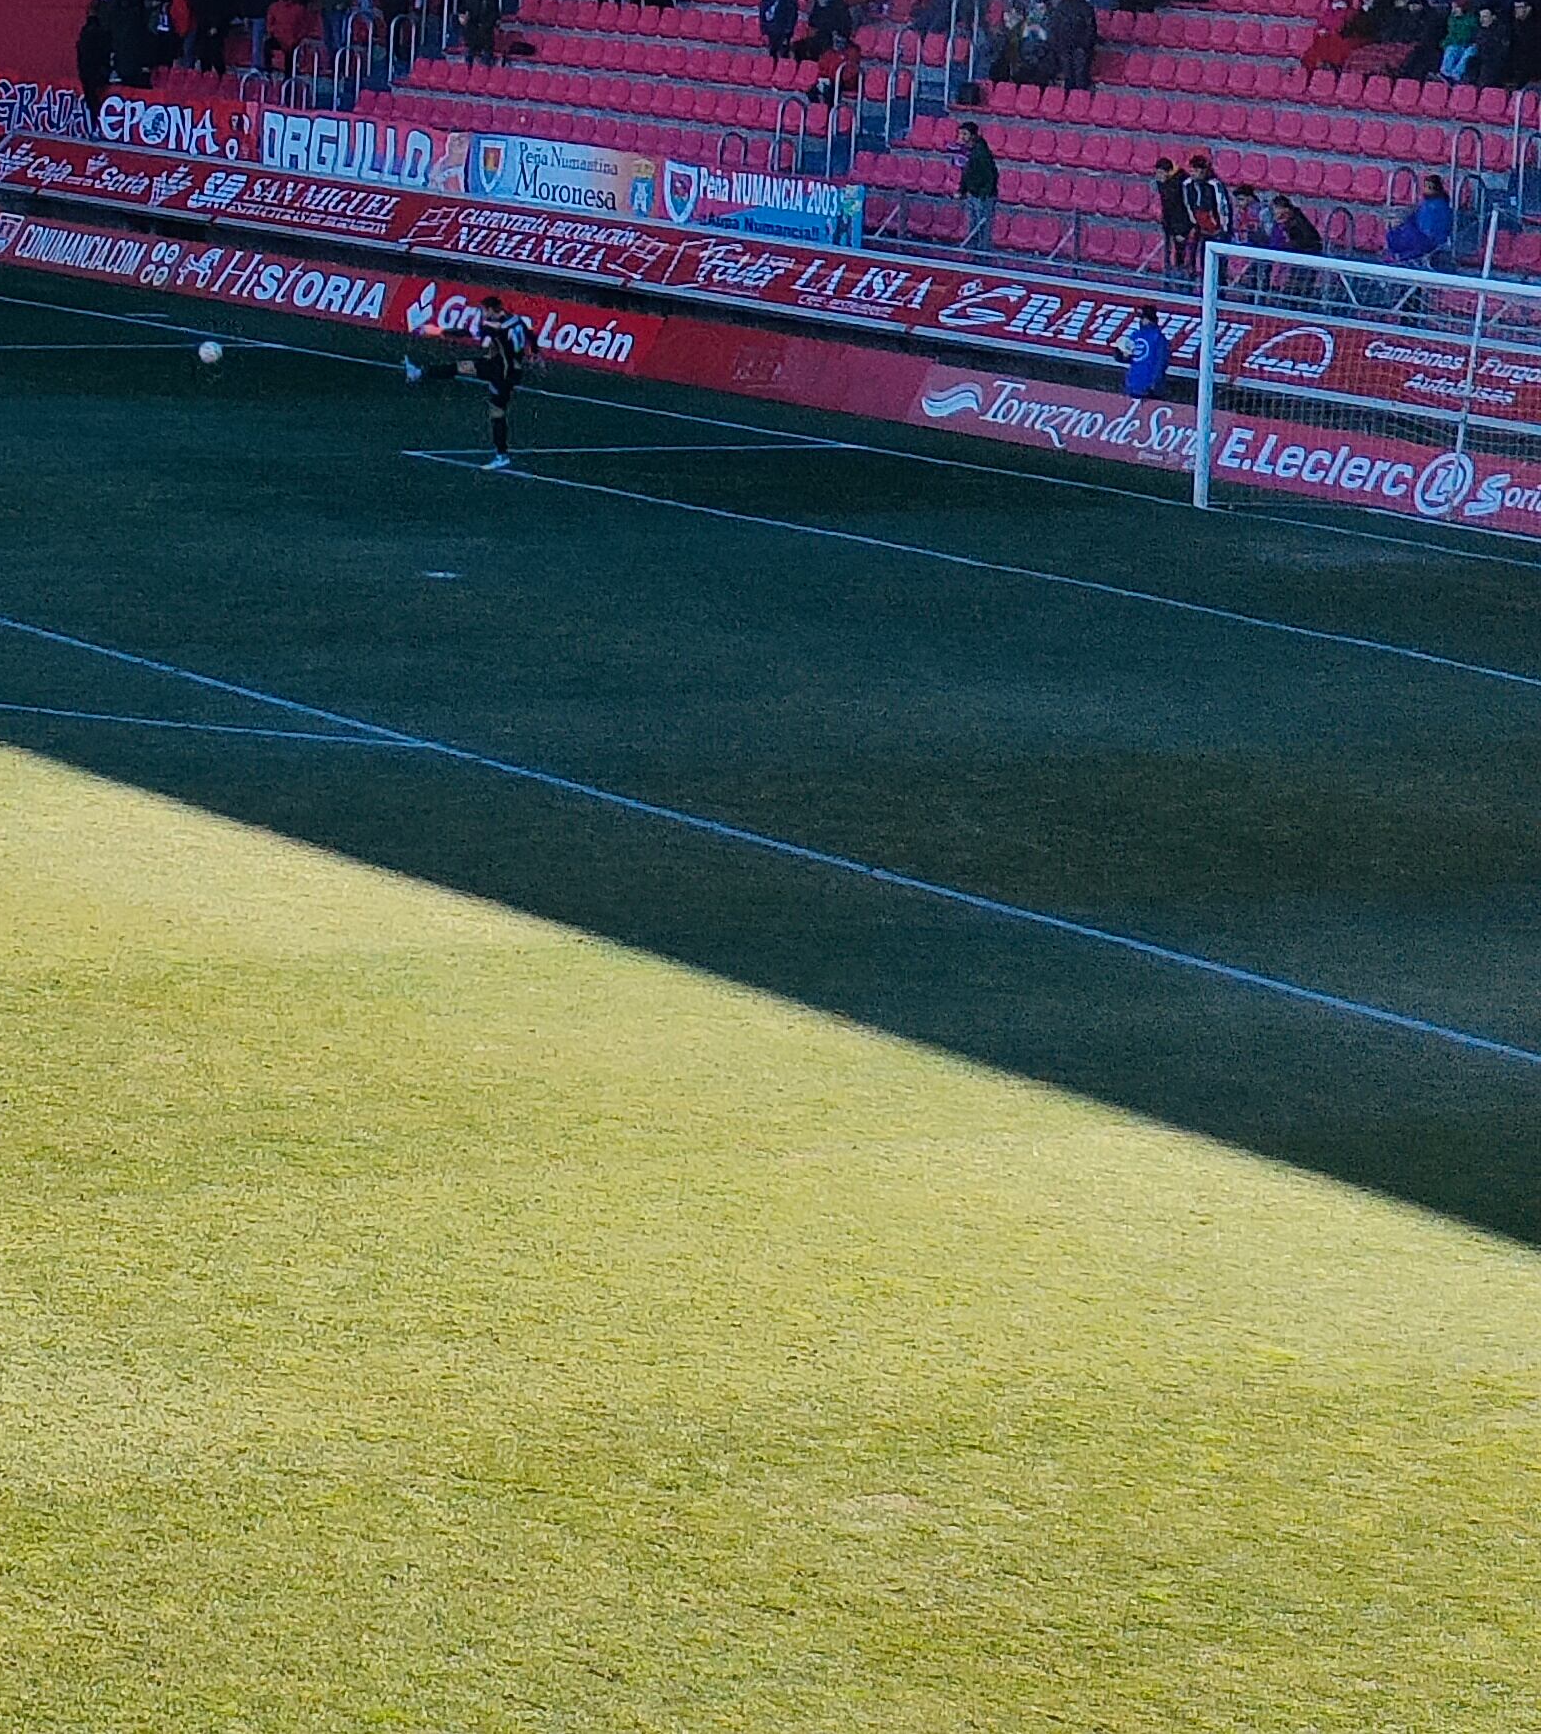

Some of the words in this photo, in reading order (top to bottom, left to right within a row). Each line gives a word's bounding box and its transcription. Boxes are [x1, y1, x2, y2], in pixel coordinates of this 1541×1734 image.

[100, 96, 219, 155] EPONA
[261, 110, 433, 187] ORGULLO
[297, 184, 402, 219] MIGUEL
[513, 166, 617, 211] Moronesa
[732, 172, 804, 213] NUMANCIA
[444, 226, 607, 272] NUMANCIA
[537, 312, 634, 362] Losán
[979, 380, 1105, 449] Torrezno
[1101, 397, 1142, 446] de
[1217, 427, 1414, 498] E.Leclerc
